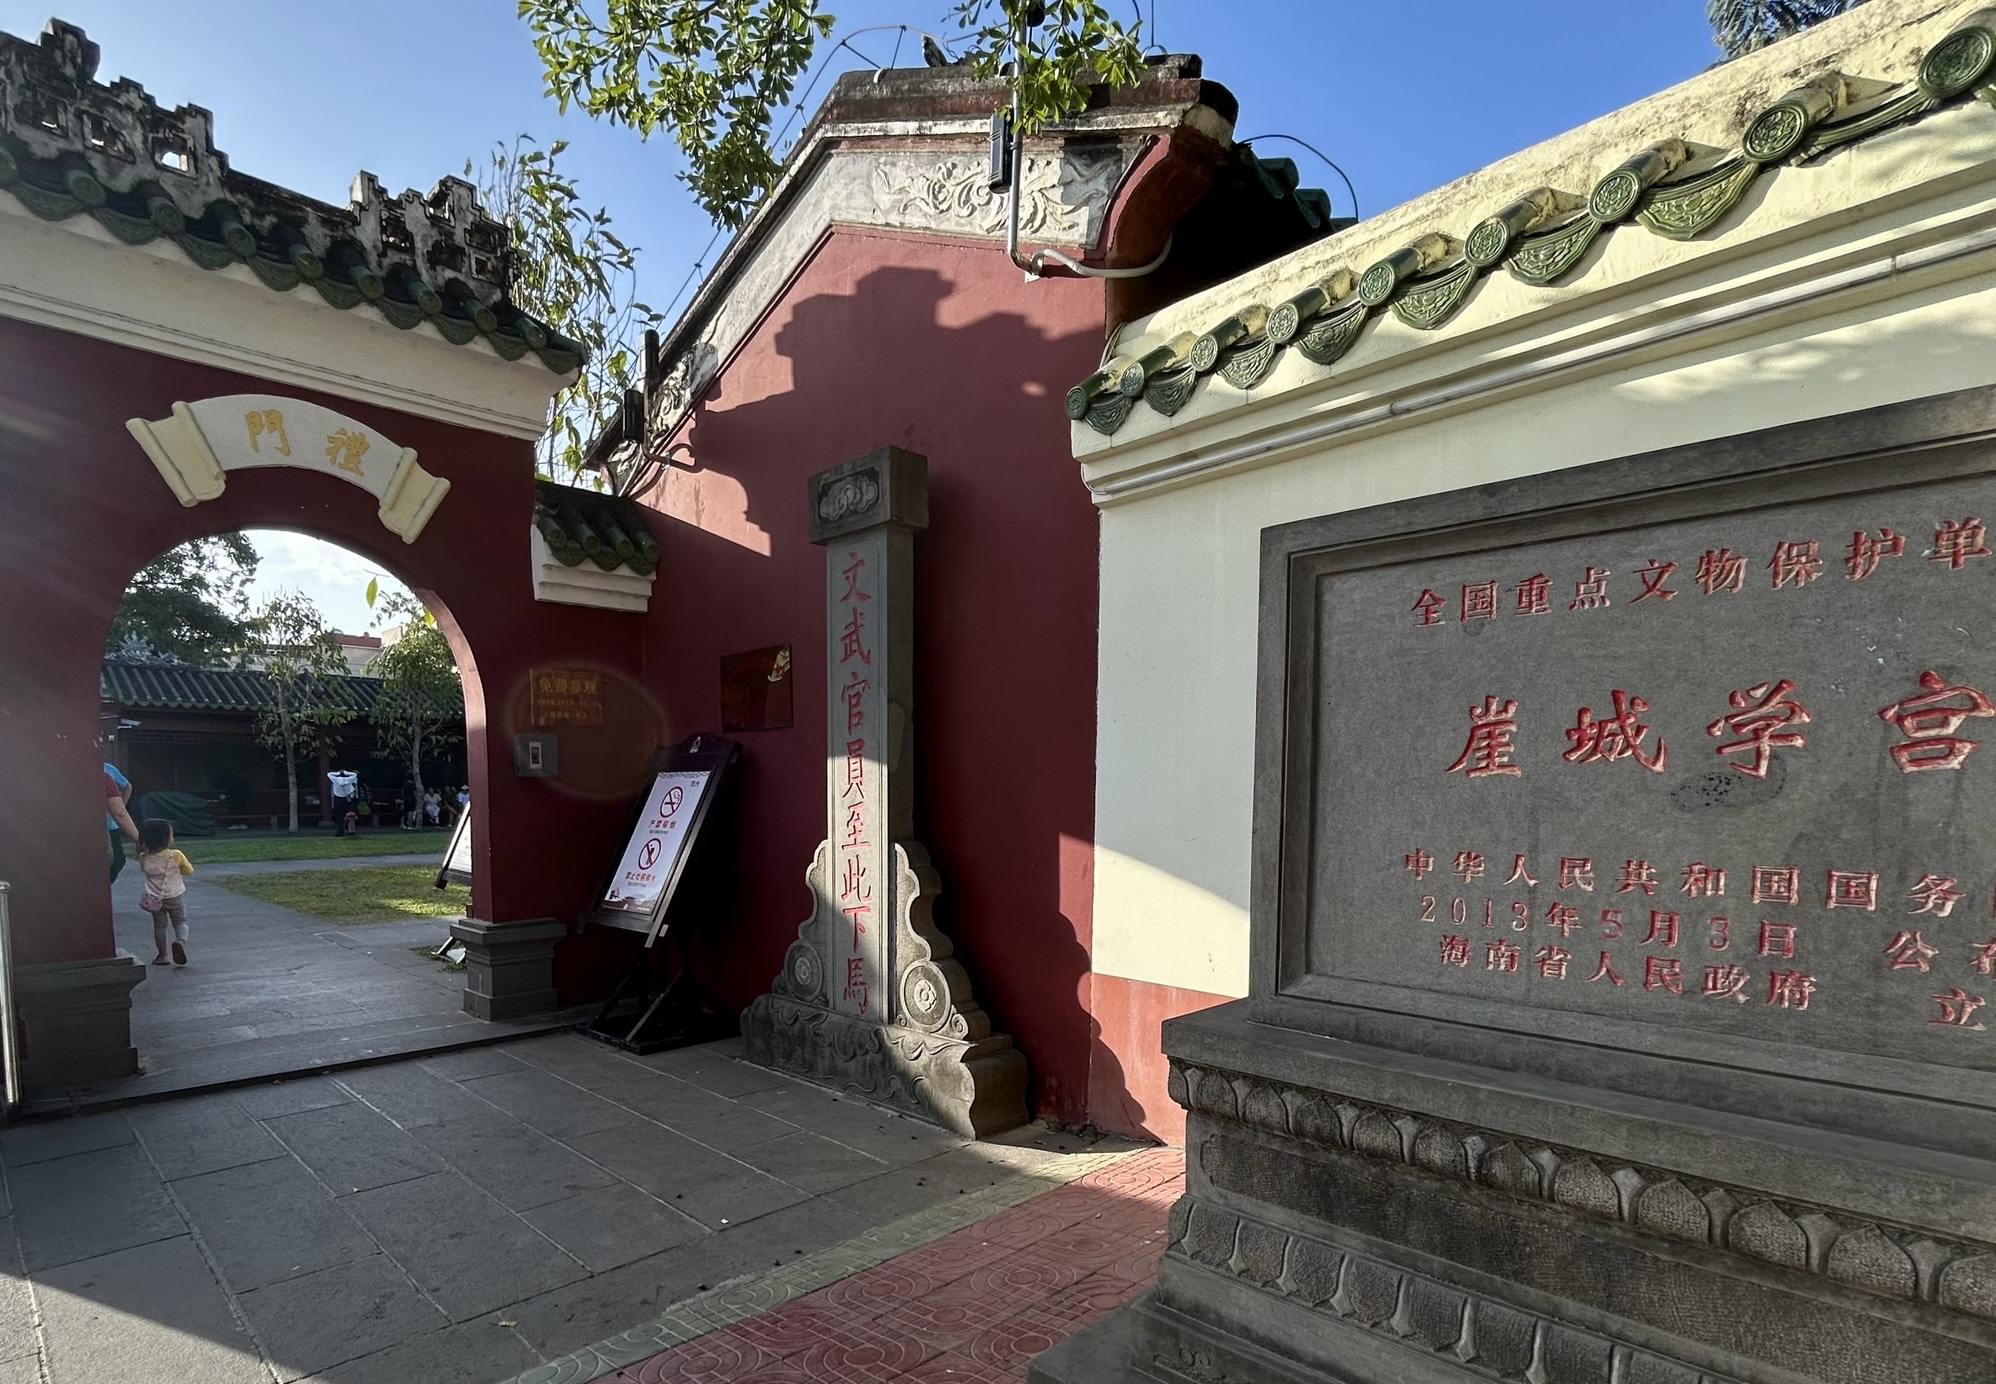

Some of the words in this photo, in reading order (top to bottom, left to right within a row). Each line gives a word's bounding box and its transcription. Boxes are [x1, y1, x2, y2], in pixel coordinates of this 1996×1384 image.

[1411, 517, 1992, 627] 全国重点文物保护单
[1446, 670, 1995, 780] 崖城学宫
[839, 551, 873, 1015] 文武官員至此下馬
[1405, 848, 1996, 917] 中华人民共和国国务
[1439, 934, 1816, 1011] 海南省人民政府
[1928, 988, 1988, 1032] 立
